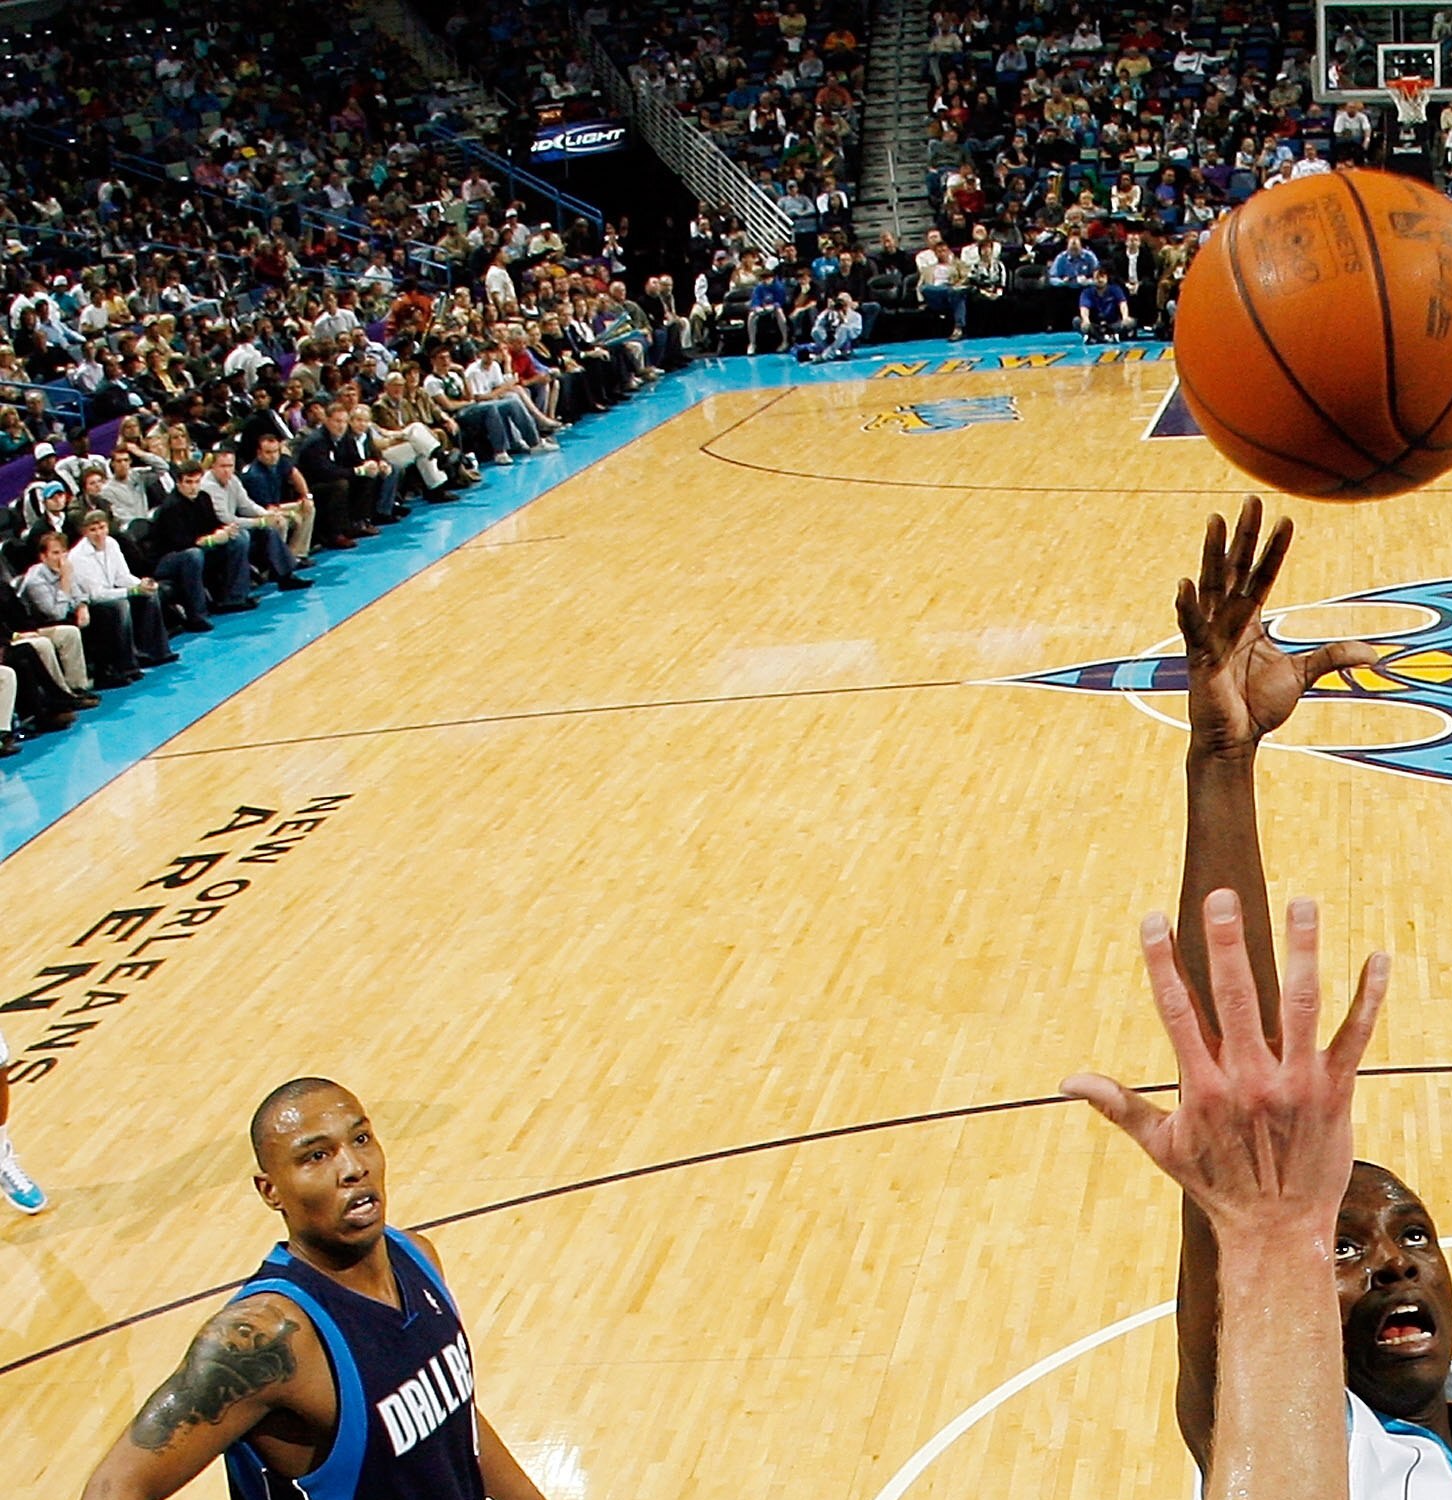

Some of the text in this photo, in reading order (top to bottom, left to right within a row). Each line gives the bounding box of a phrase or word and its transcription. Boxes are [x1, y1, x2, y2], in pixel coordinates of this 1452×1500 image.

[565, 129, 626, 147] LIGHT
[5, 793, 356, 1085] NEW ORLEANS
